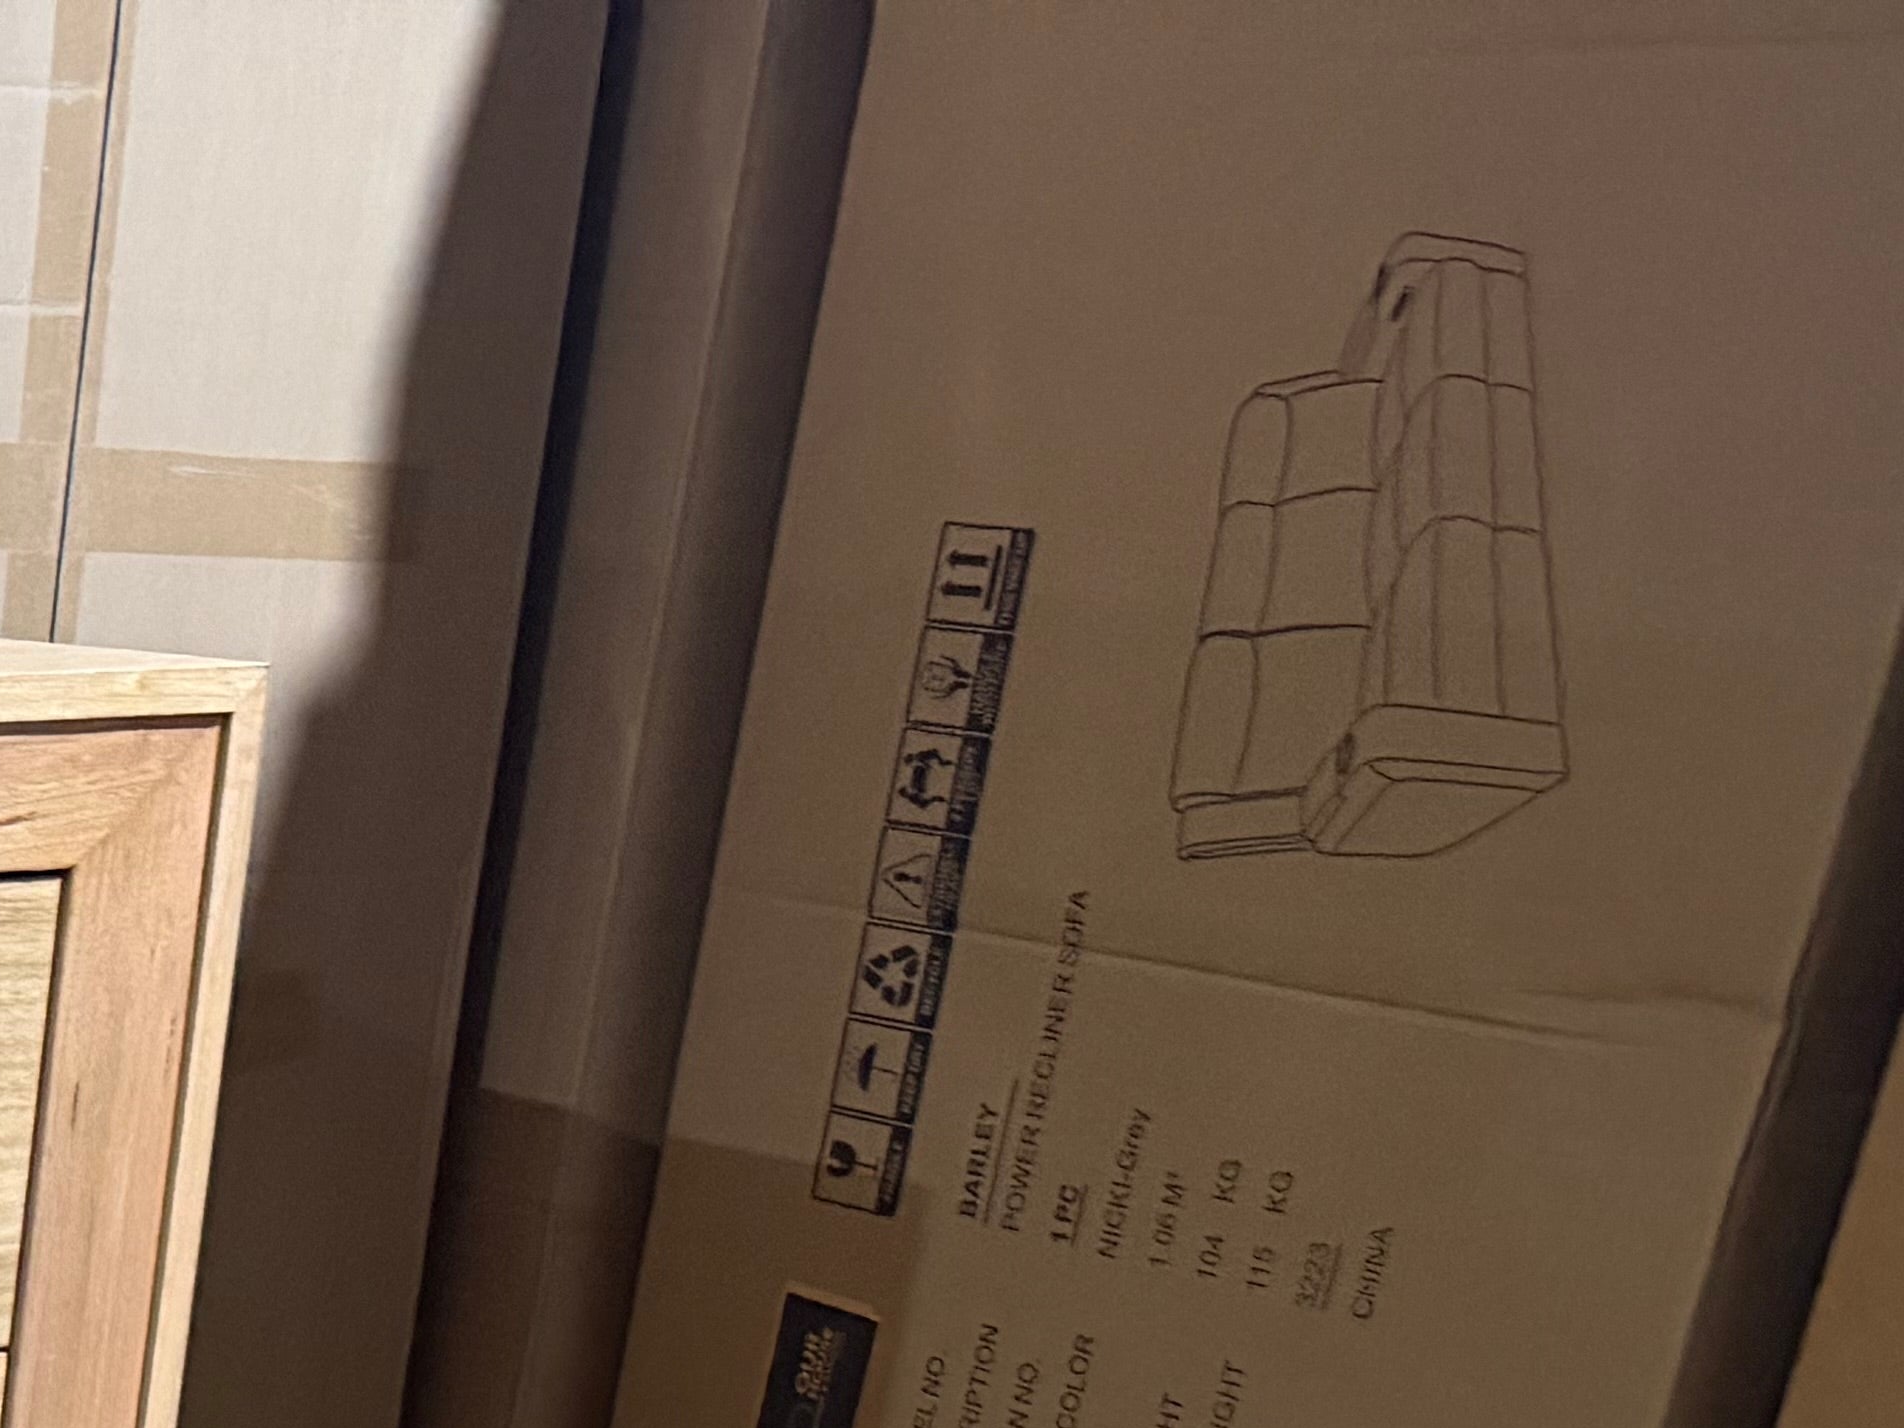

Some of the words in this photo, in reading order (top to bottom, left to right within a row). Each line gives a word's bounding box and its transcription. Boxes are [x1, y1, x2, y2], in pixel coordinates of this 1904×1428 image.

[999, 1125, 1044, 1232] POWER
[1024, 973, 1076, 1120] RECLINER
[1057, 890, 1090, 967] SOFA
[956, 1102, 999, 1220] BARLEY
[1210, 1159, 1244, 1204] KG
[1261, 1171, 1295, 1215] KG
[1053, 1184, 1082, 1228] PC
[1350, 1227, 1395, 1321] CHINA
